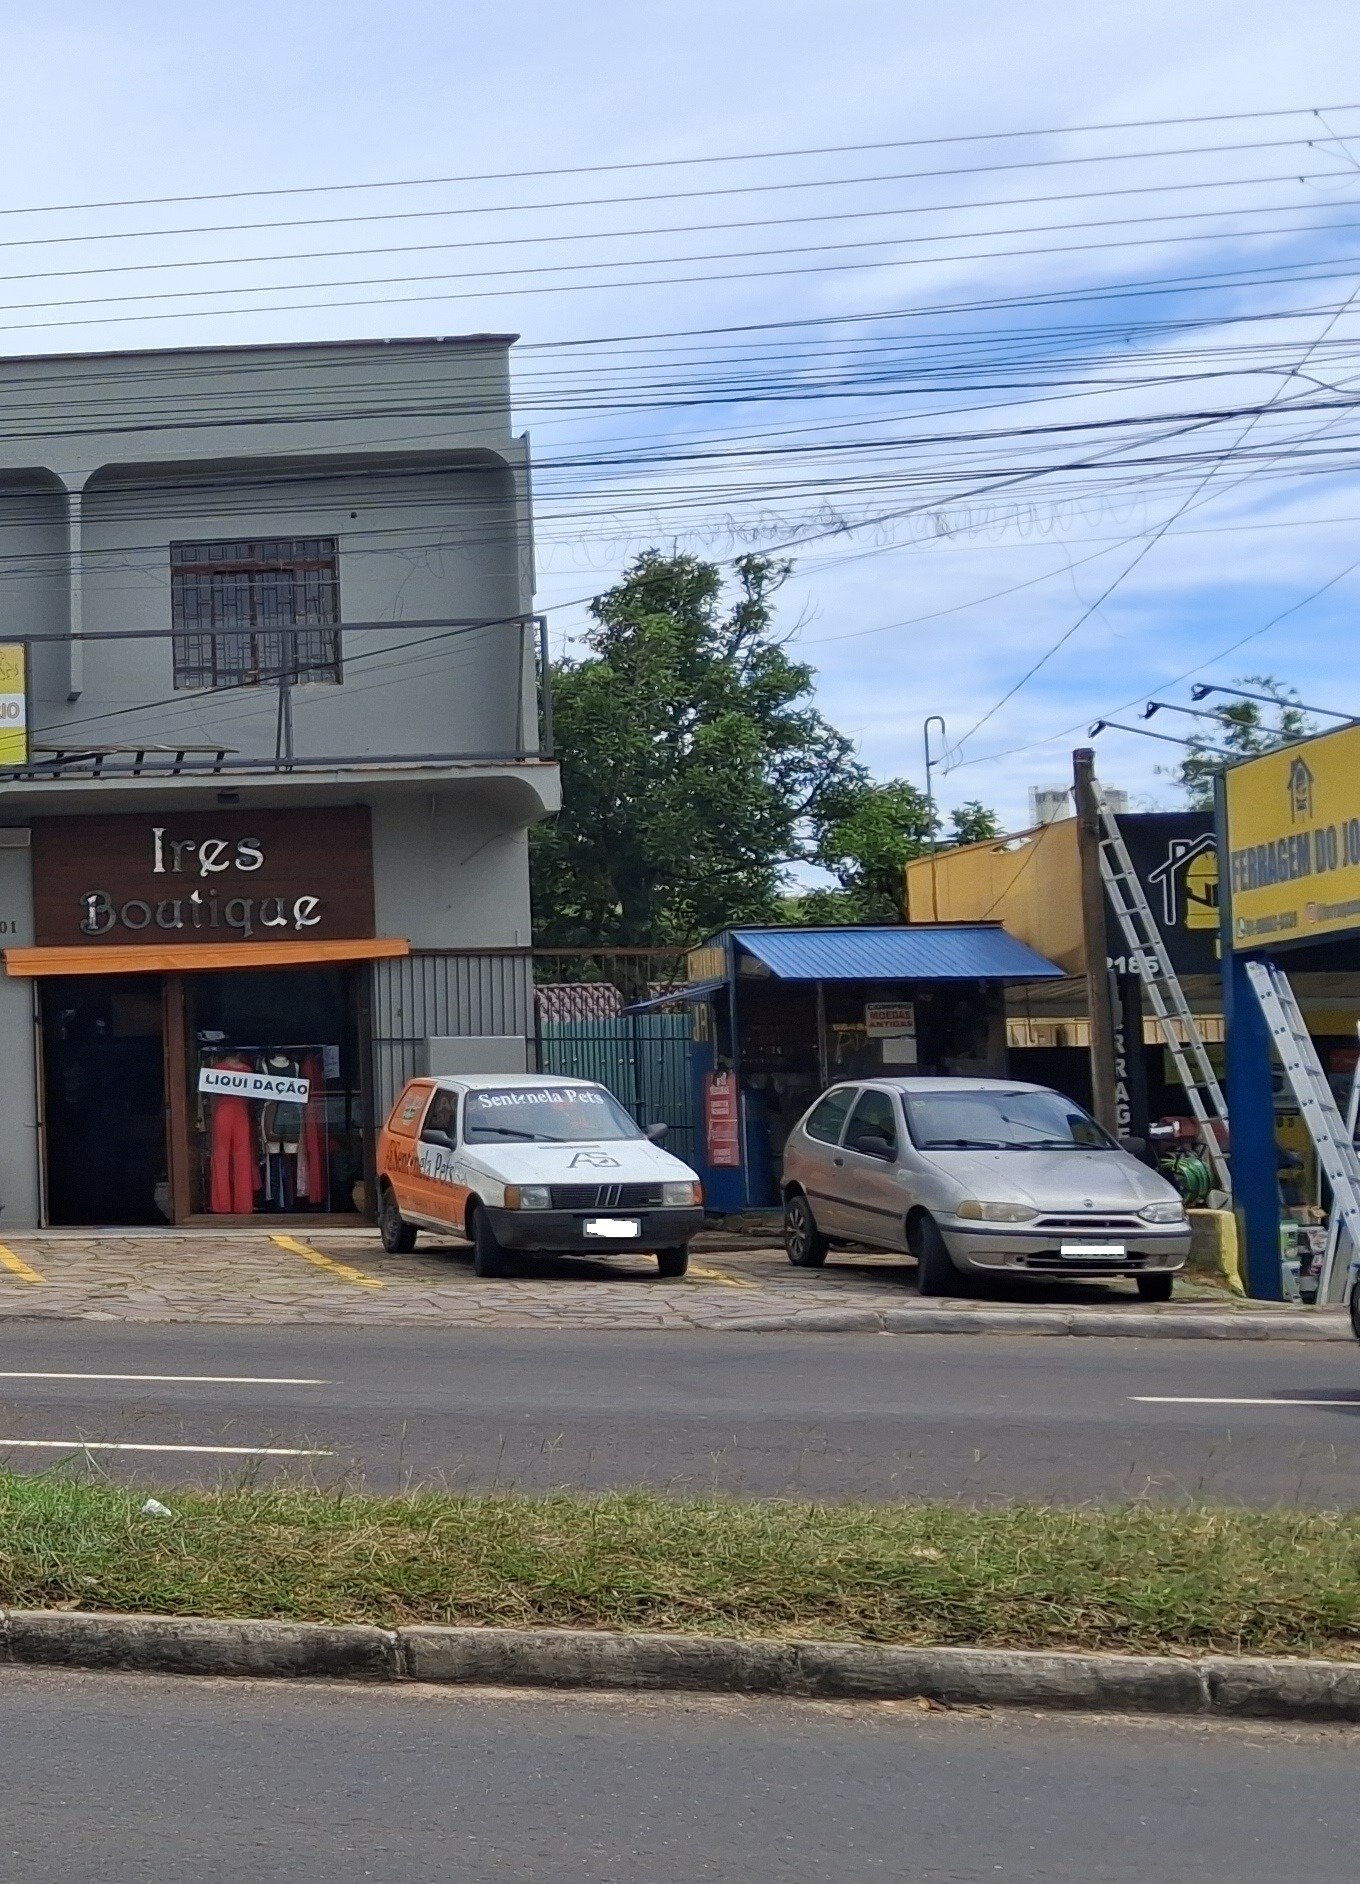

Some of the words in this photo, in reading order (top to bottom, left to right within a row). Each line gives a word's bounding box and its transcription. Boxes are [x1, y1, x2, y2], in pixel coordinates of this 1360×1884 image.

[152, 827, 264, 877] Ires
[80, 889, 322, 937] Boutique
[206, 1073, 248, 1088] LIQUI
[253, 1079, 308, 1096] DAÇÃO
